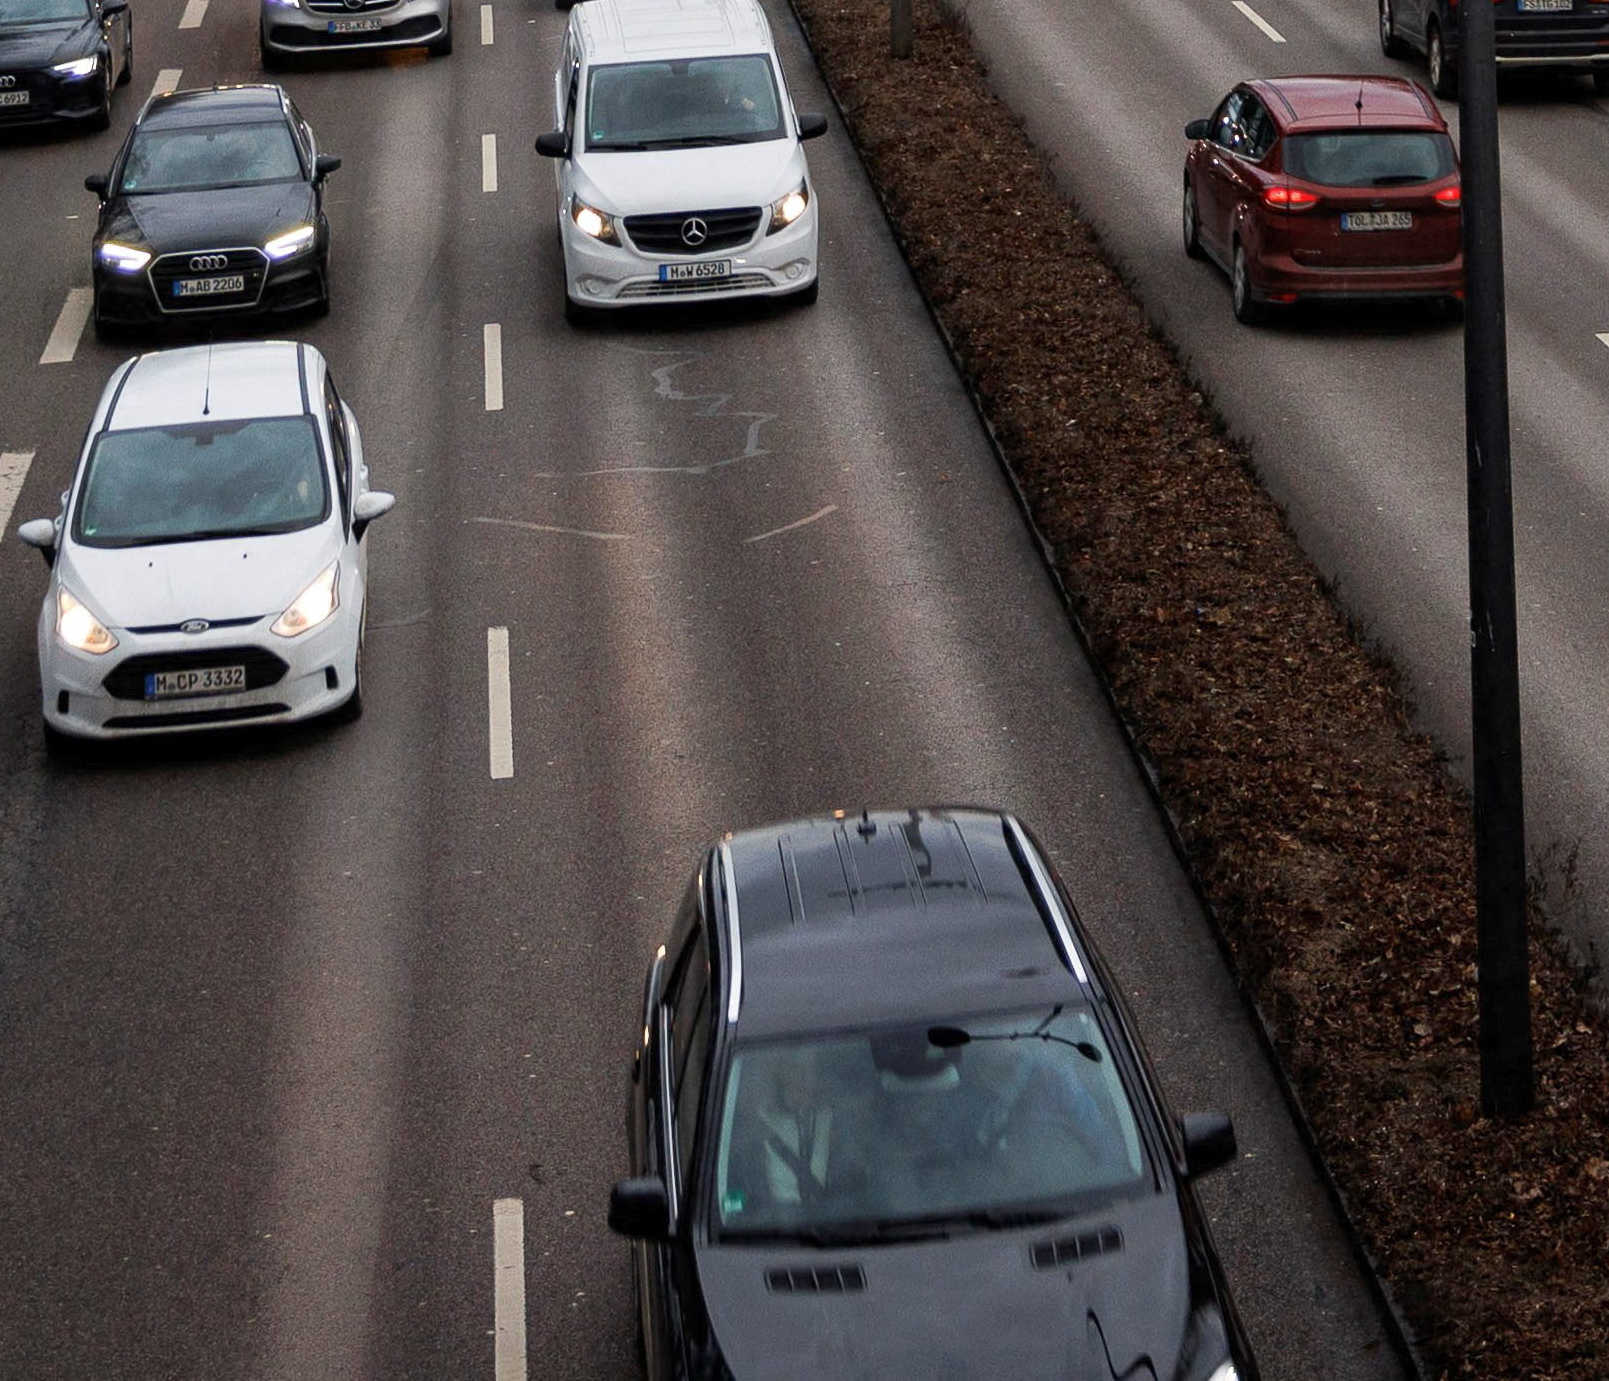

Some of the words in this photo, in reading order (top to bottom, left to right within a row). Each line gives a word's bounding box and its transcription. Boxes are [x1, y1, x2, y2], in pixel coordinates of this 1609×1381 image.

[671, 267, 680, 278] M
[686, 267, 694, 277] W
[696, 264, 725, 276] 6528
[180, 282, 188, 292] M
[196, 280, 211, 291] AB
[214, 278, 242, 290] 2206
[156, 674, 167, 688] M
[177, 672, 199, 688] CP
[204, 669, 244, 686] 3332
